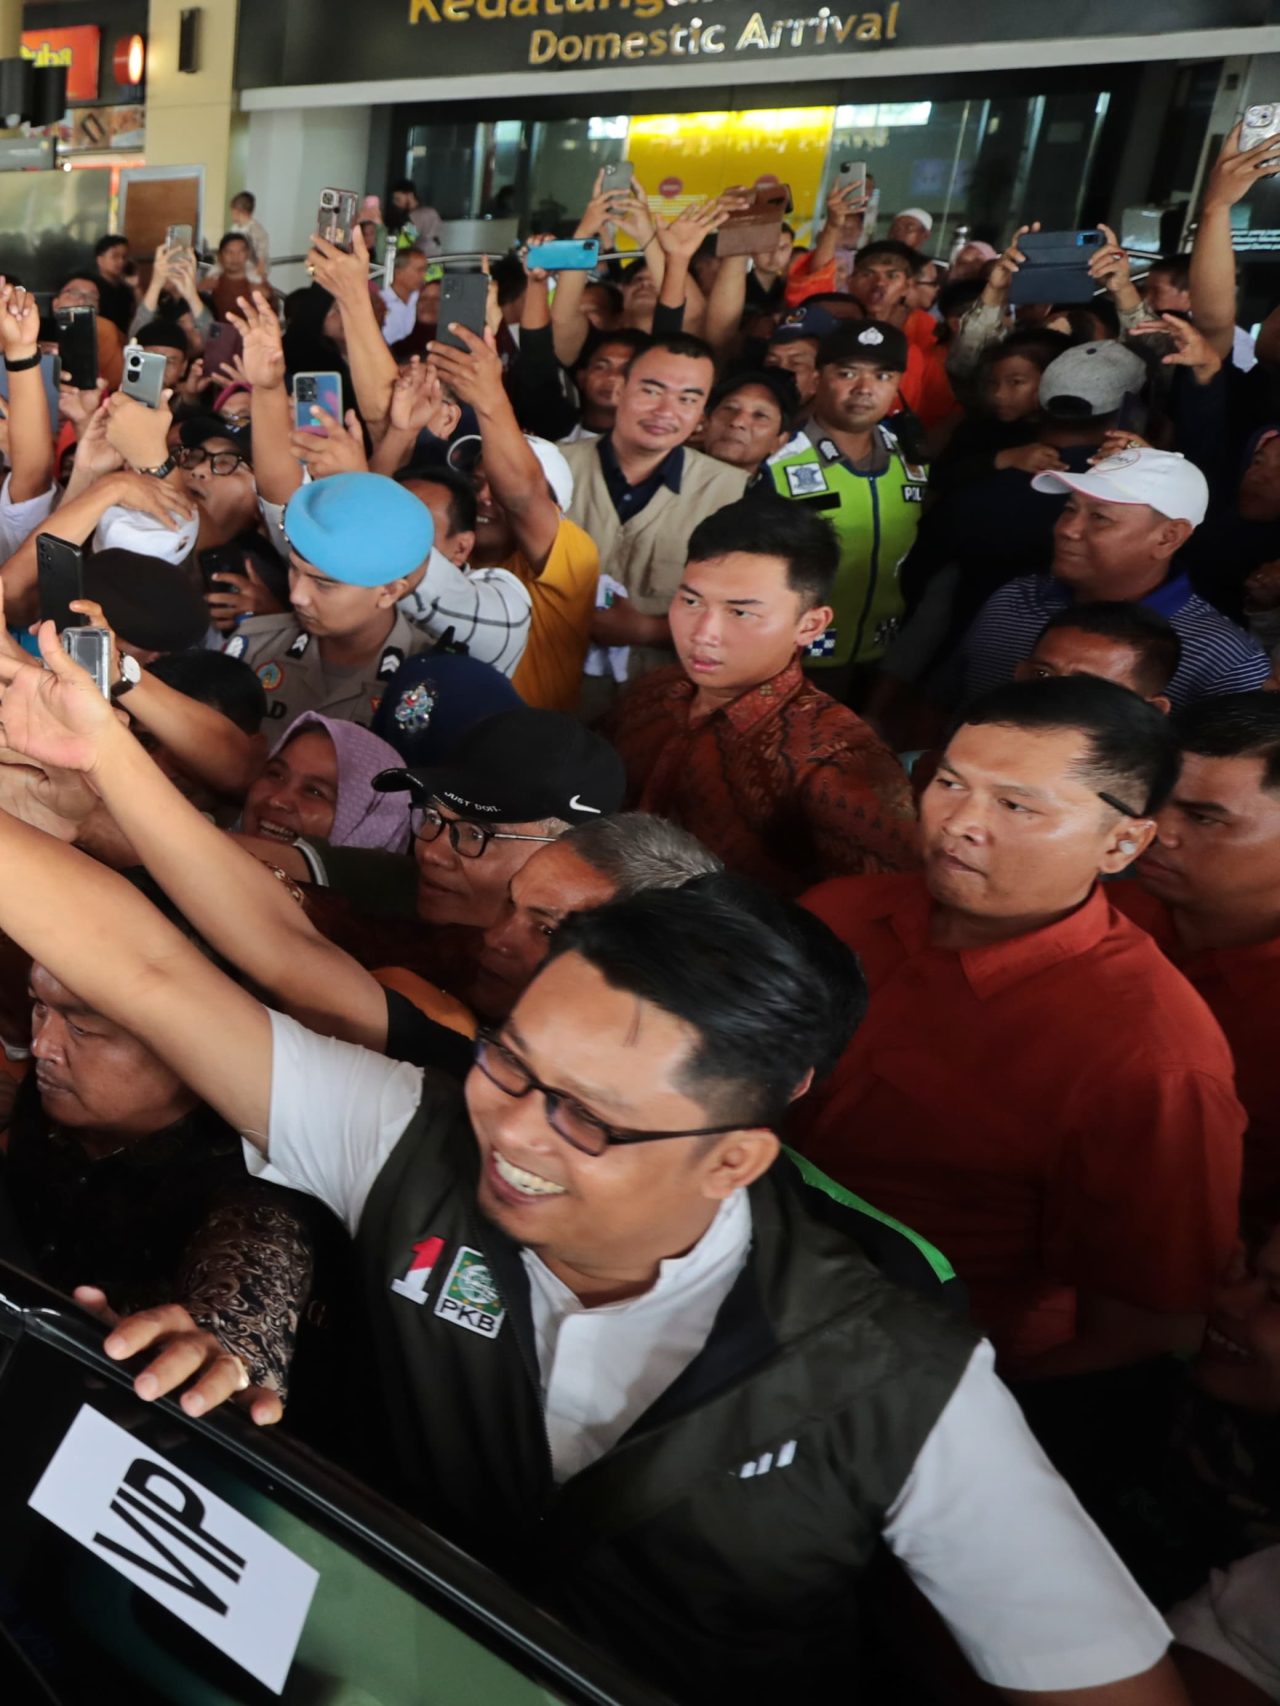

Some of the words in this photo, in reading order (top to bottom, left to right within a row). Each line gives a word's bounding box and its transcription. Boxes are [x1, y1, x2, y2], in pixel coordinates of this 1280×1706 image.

[528, 17, 726, 64] Domestic
[735, 1, 900, 51] Arrival
[444, 791, 471, 807] JUST
[391, 1236, 445, 1305] 1
[440, 1298, 496, 1332] PKB
[92, 1457, 247, 1618] VIP
